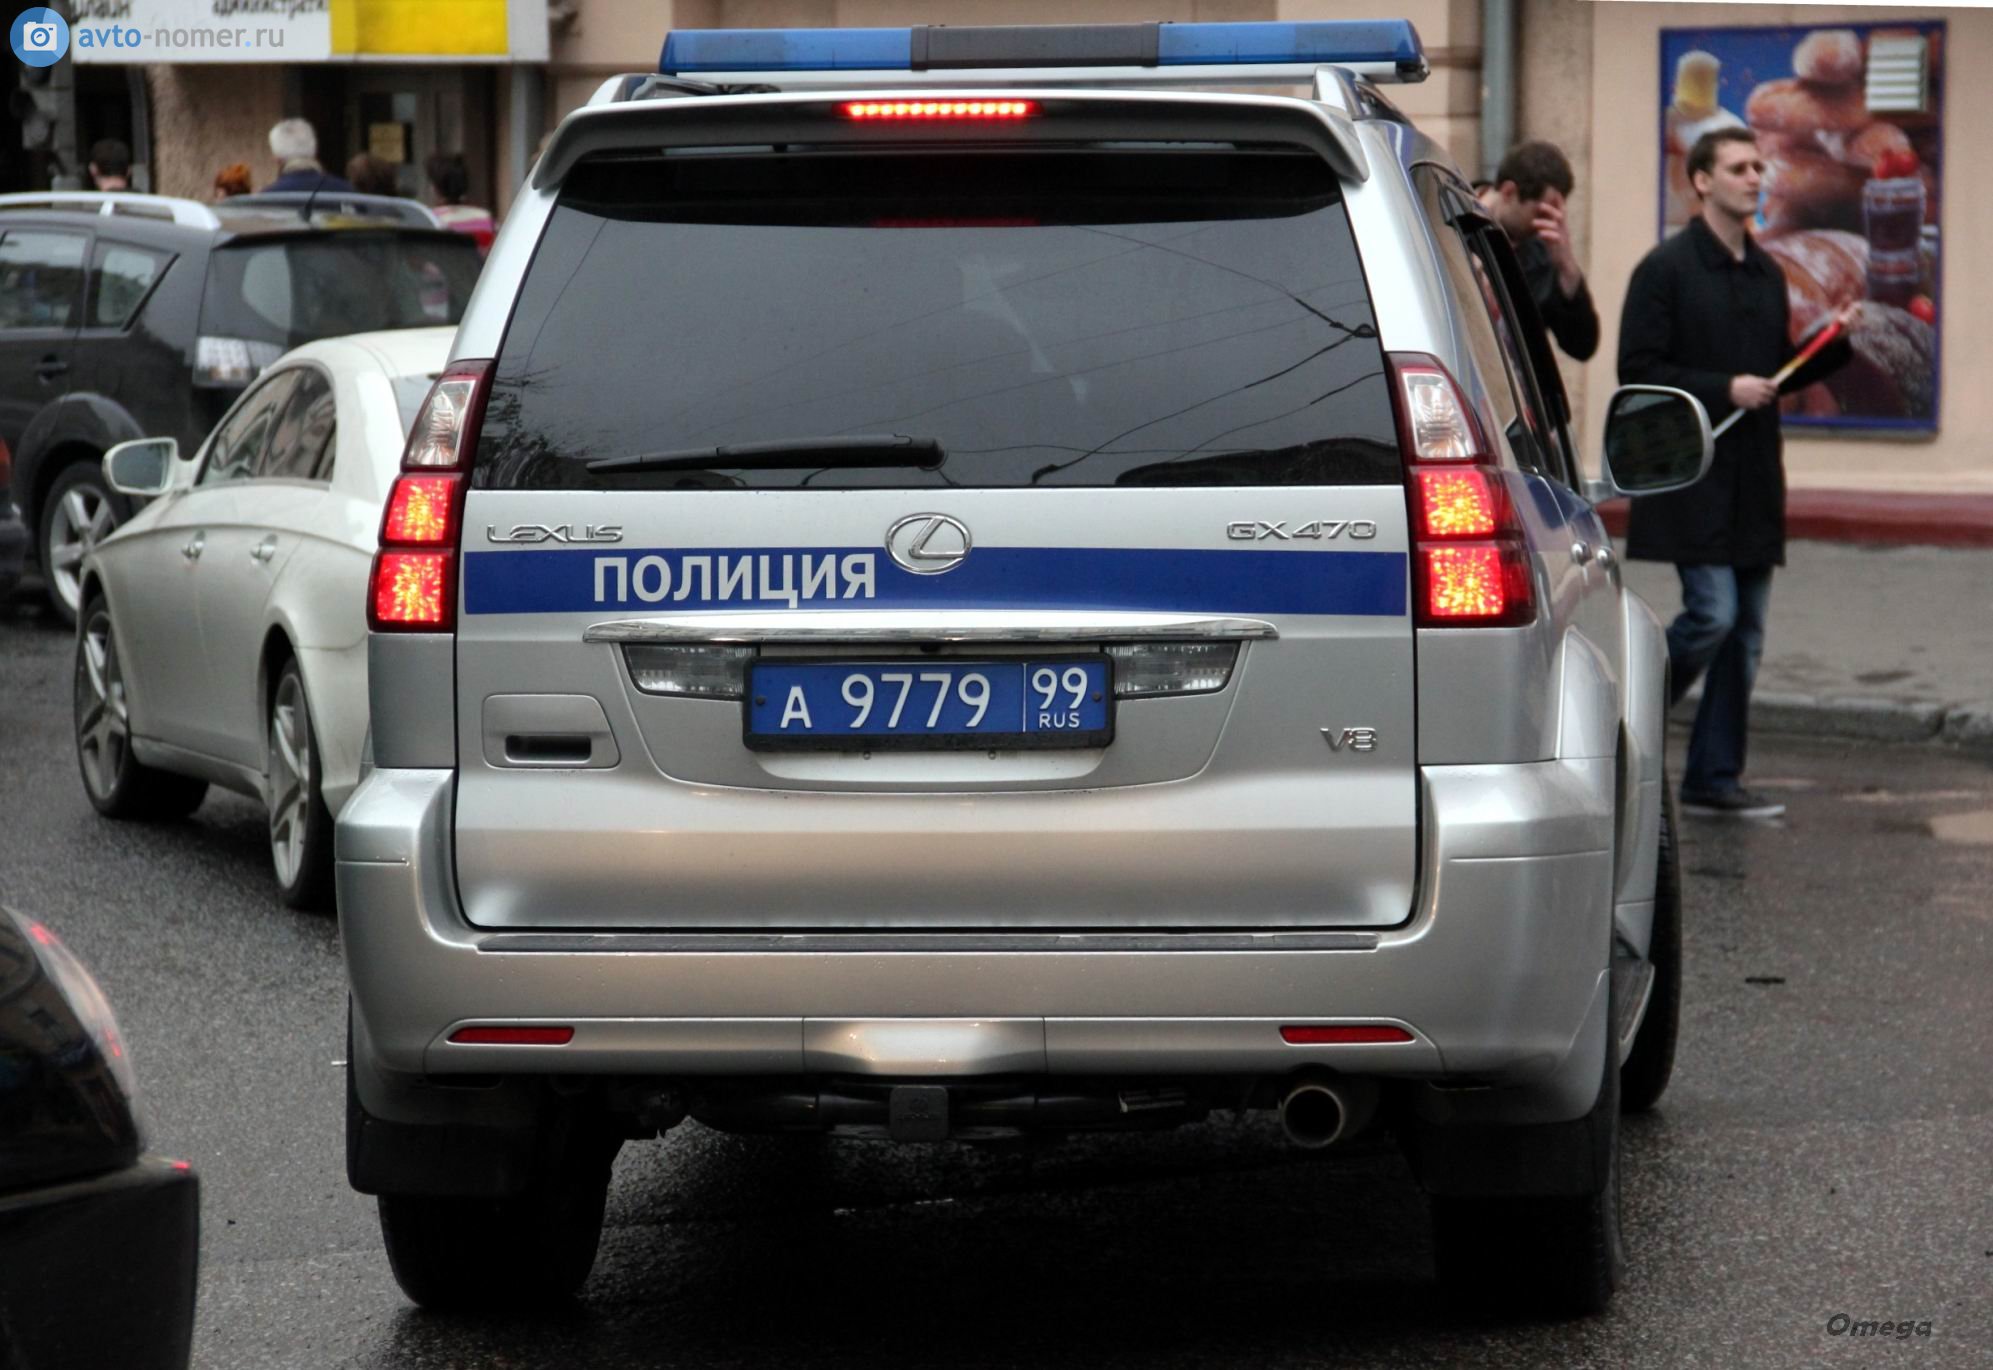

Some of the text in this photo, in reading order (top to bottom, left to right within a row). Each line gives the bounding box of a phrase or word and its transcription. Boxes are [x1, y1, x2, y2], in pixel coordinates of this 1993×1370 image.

[486, 524, 624, 544] LEXUS
[1226, 520, 1378, 541] GX470
[593, 553, 876, 609] ПОЛИЦИЯ
[841, 673, 991, 729] 9779
[1031, 667, 1089, 710] 99
[1038, 712, 1081, 729] RUS
[1319, 726, 1380, 753] V8
